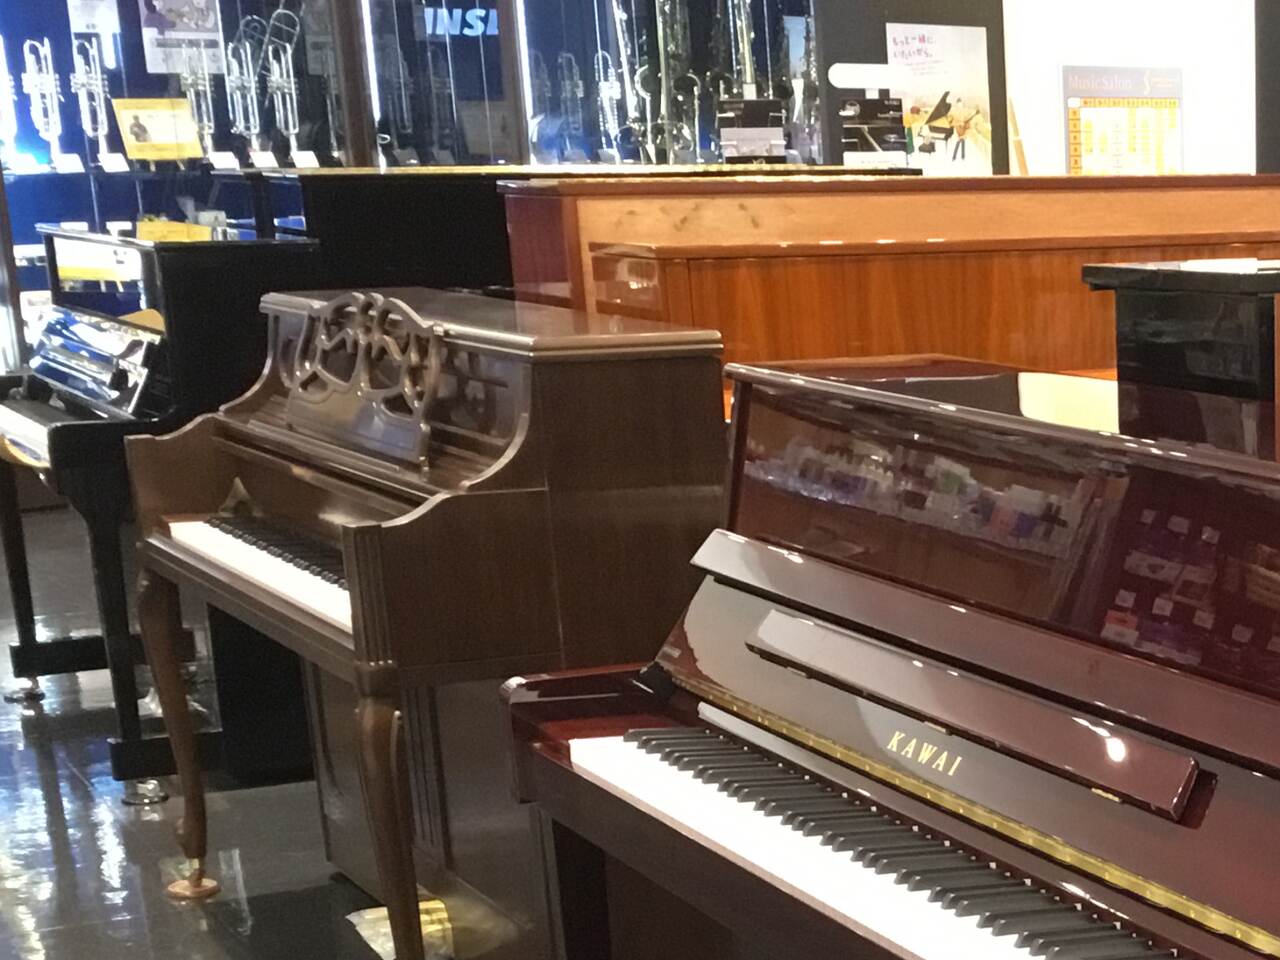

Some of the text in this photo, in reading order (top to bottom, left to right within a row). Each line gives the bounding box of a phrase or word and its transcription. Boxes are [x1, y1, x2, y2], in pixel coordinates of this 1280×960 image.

[1068, 73, 1101, 89] Music
[1102, 73, 1132, 89] Salon
[886, 730, 963, 777] KAWAI
